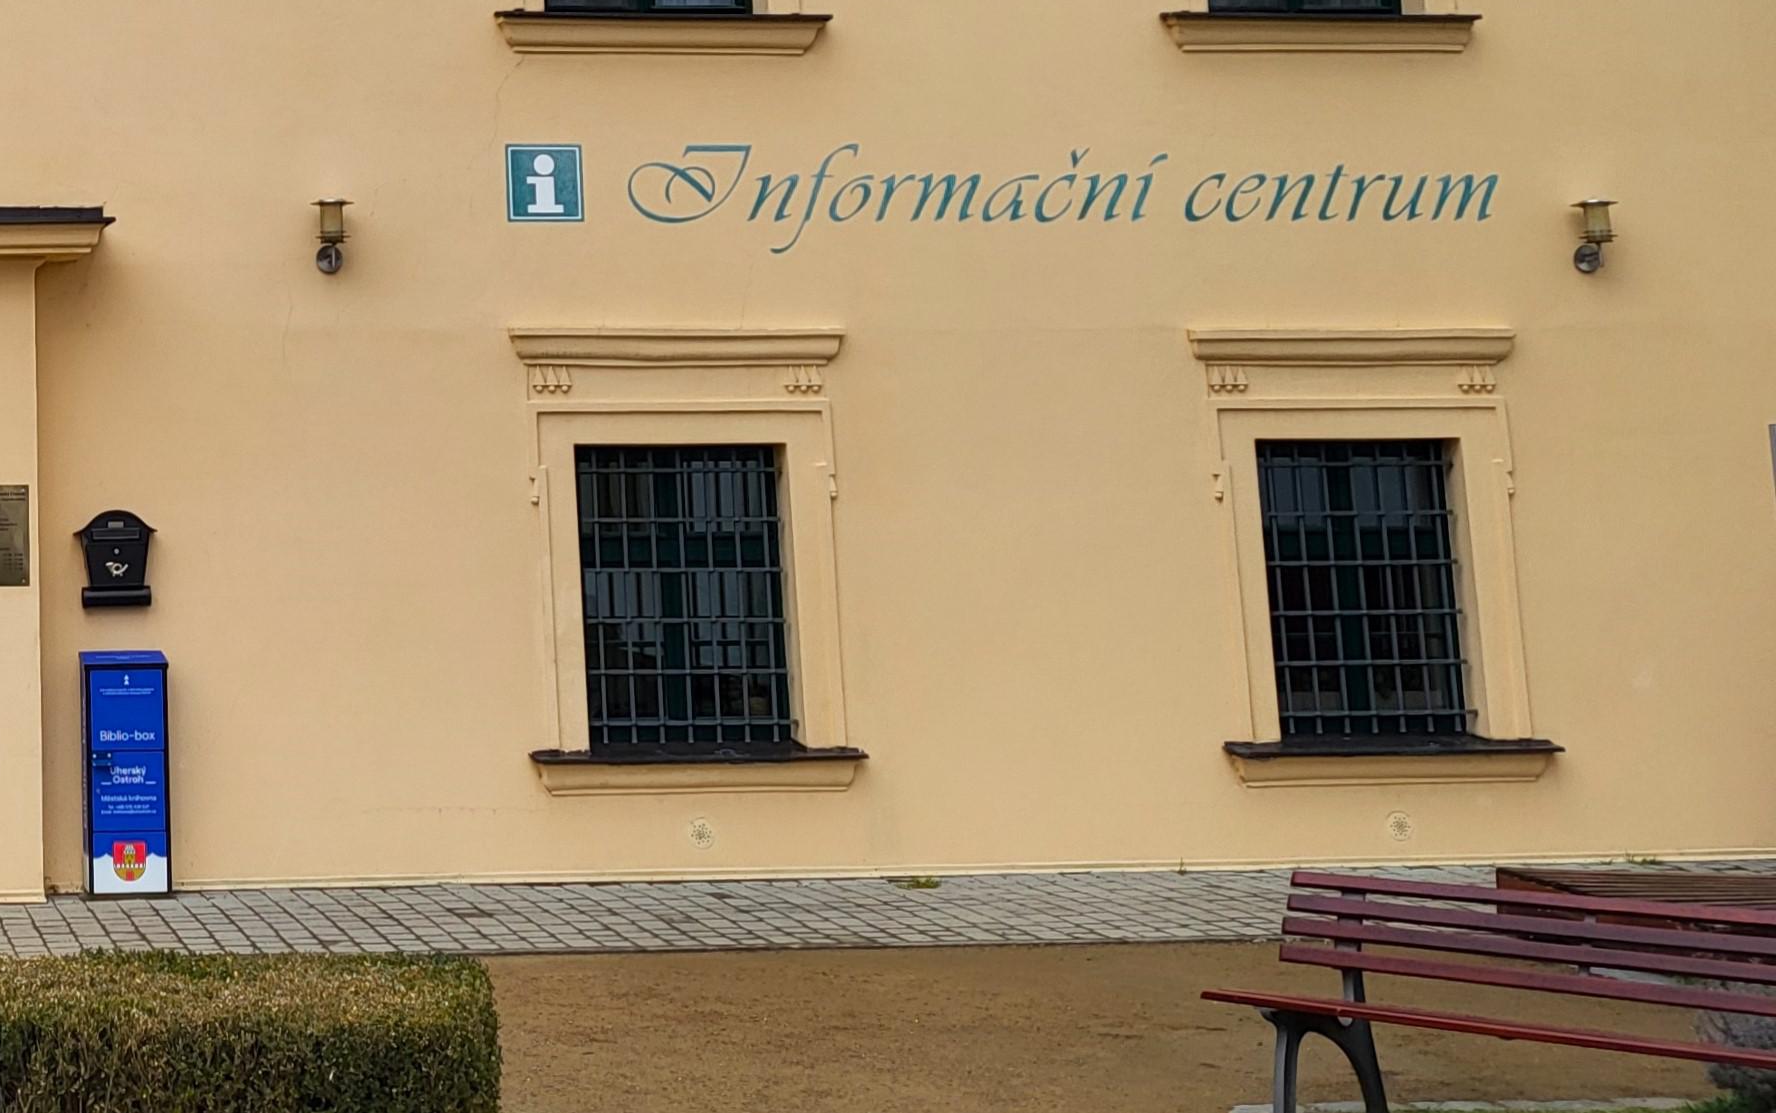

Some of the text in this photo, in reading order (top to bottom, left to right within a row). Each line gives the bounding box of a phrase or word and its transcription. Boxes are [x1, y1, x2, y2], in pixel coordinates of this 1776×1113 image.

[627, 144, 1500, 253] Informační centrum
[100, 730, 156, 742] Biblio-box
[110, 765, 146, 776] Uherský
[112, 775, 144, 784] Ostroh
